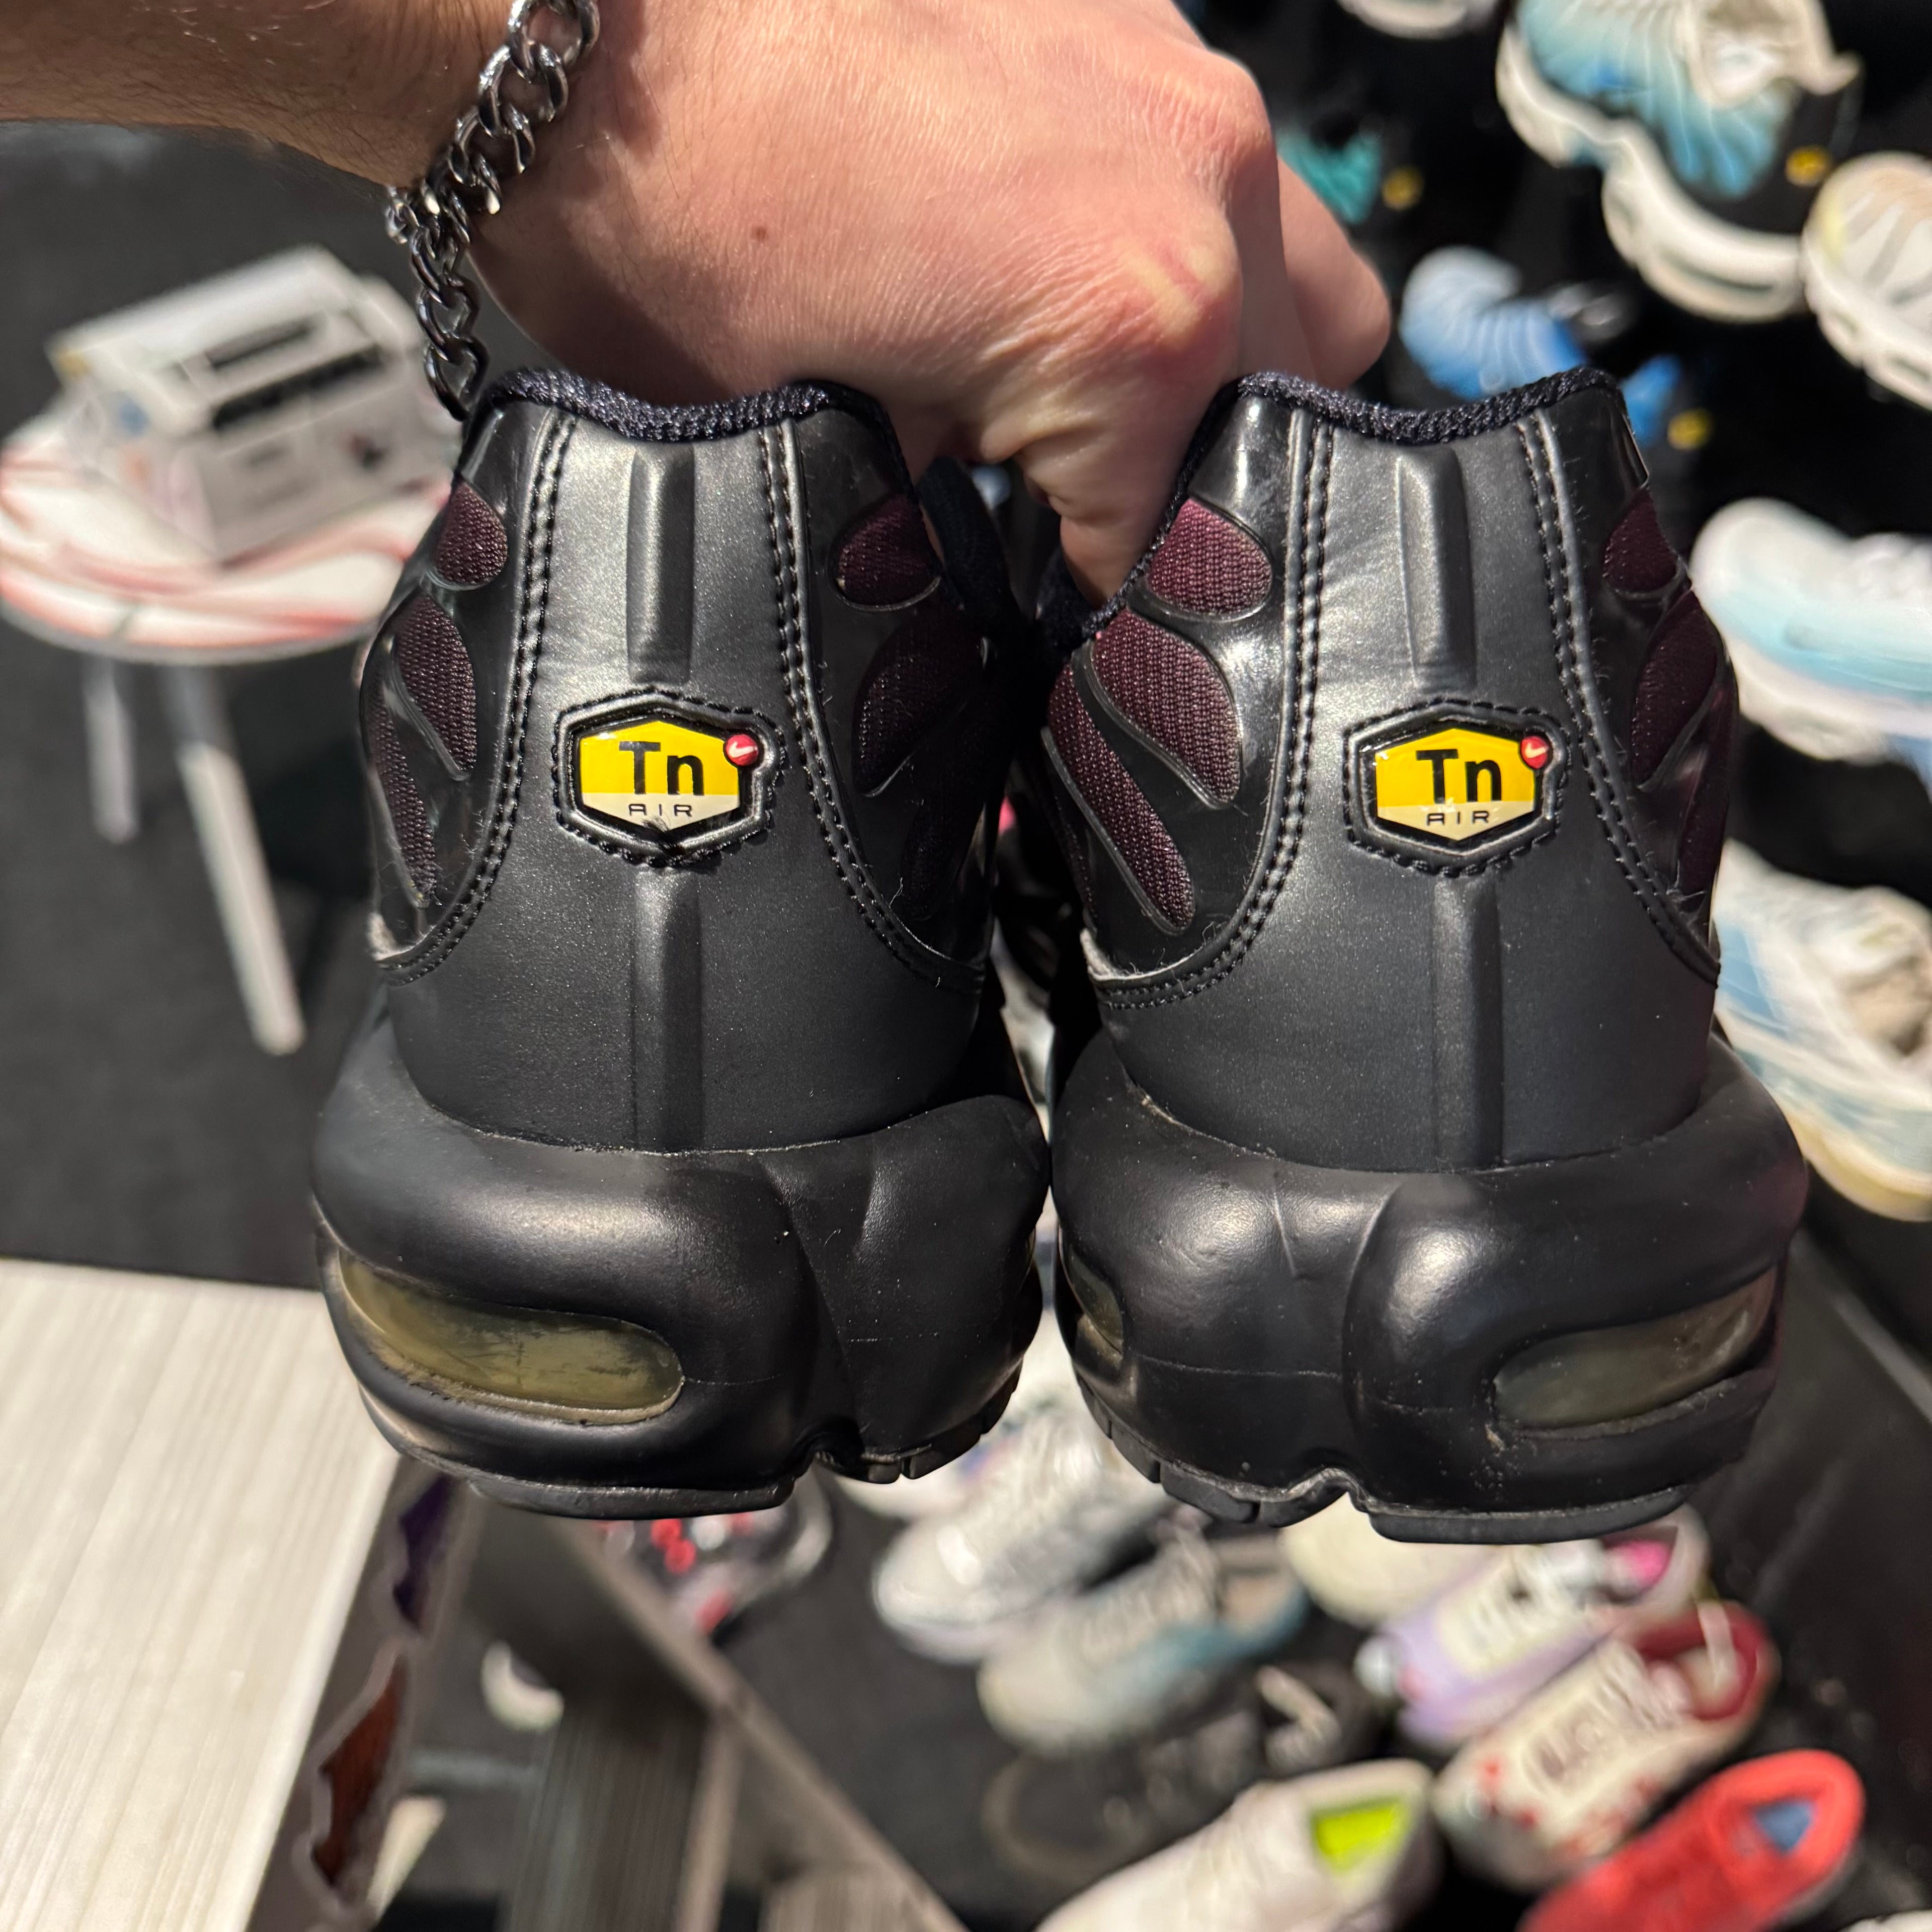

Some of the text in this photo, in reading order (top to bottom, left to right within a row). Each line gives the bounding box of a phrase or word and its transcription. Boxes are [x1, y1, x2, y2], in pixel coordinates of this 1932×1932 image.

[619, 741, 704, 795] Tn
[1416, 749, 1502, 804] Tn
[629, 803, 693, 817] AIR
[1426, 811, 1490, 826] AIR
